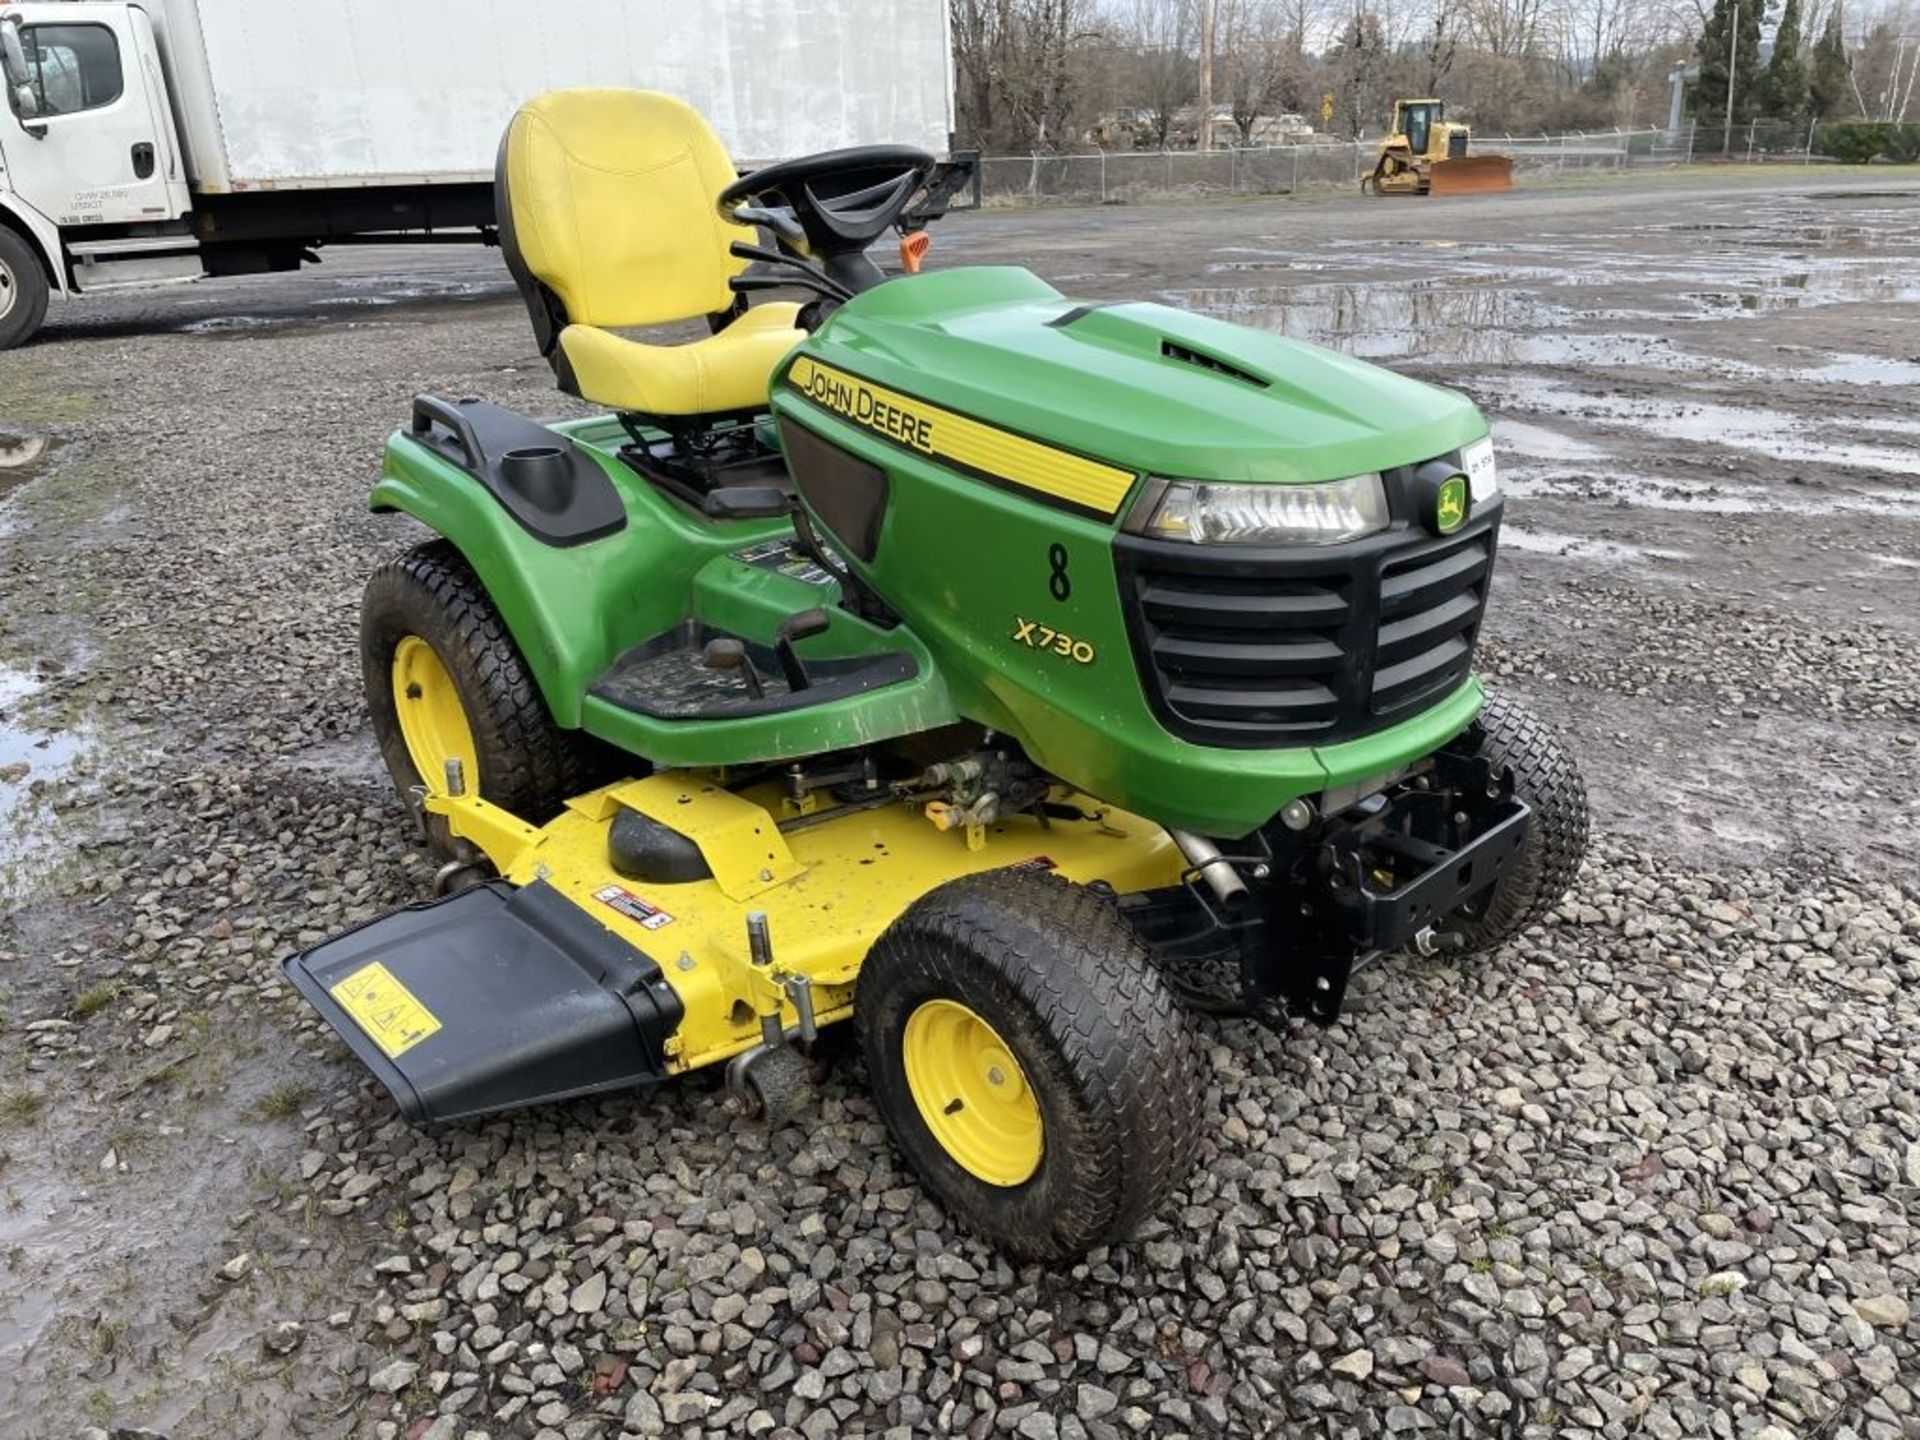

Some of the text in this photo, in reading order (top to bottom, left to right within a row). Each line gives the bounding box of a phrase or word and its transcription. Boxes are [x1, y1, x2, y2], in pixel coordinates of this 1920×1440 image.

[803, 364, 933, 449] JOHN DEERE
[1049, 543, 1071, 602] 8
[1012, 616, 1094, 663] X730
